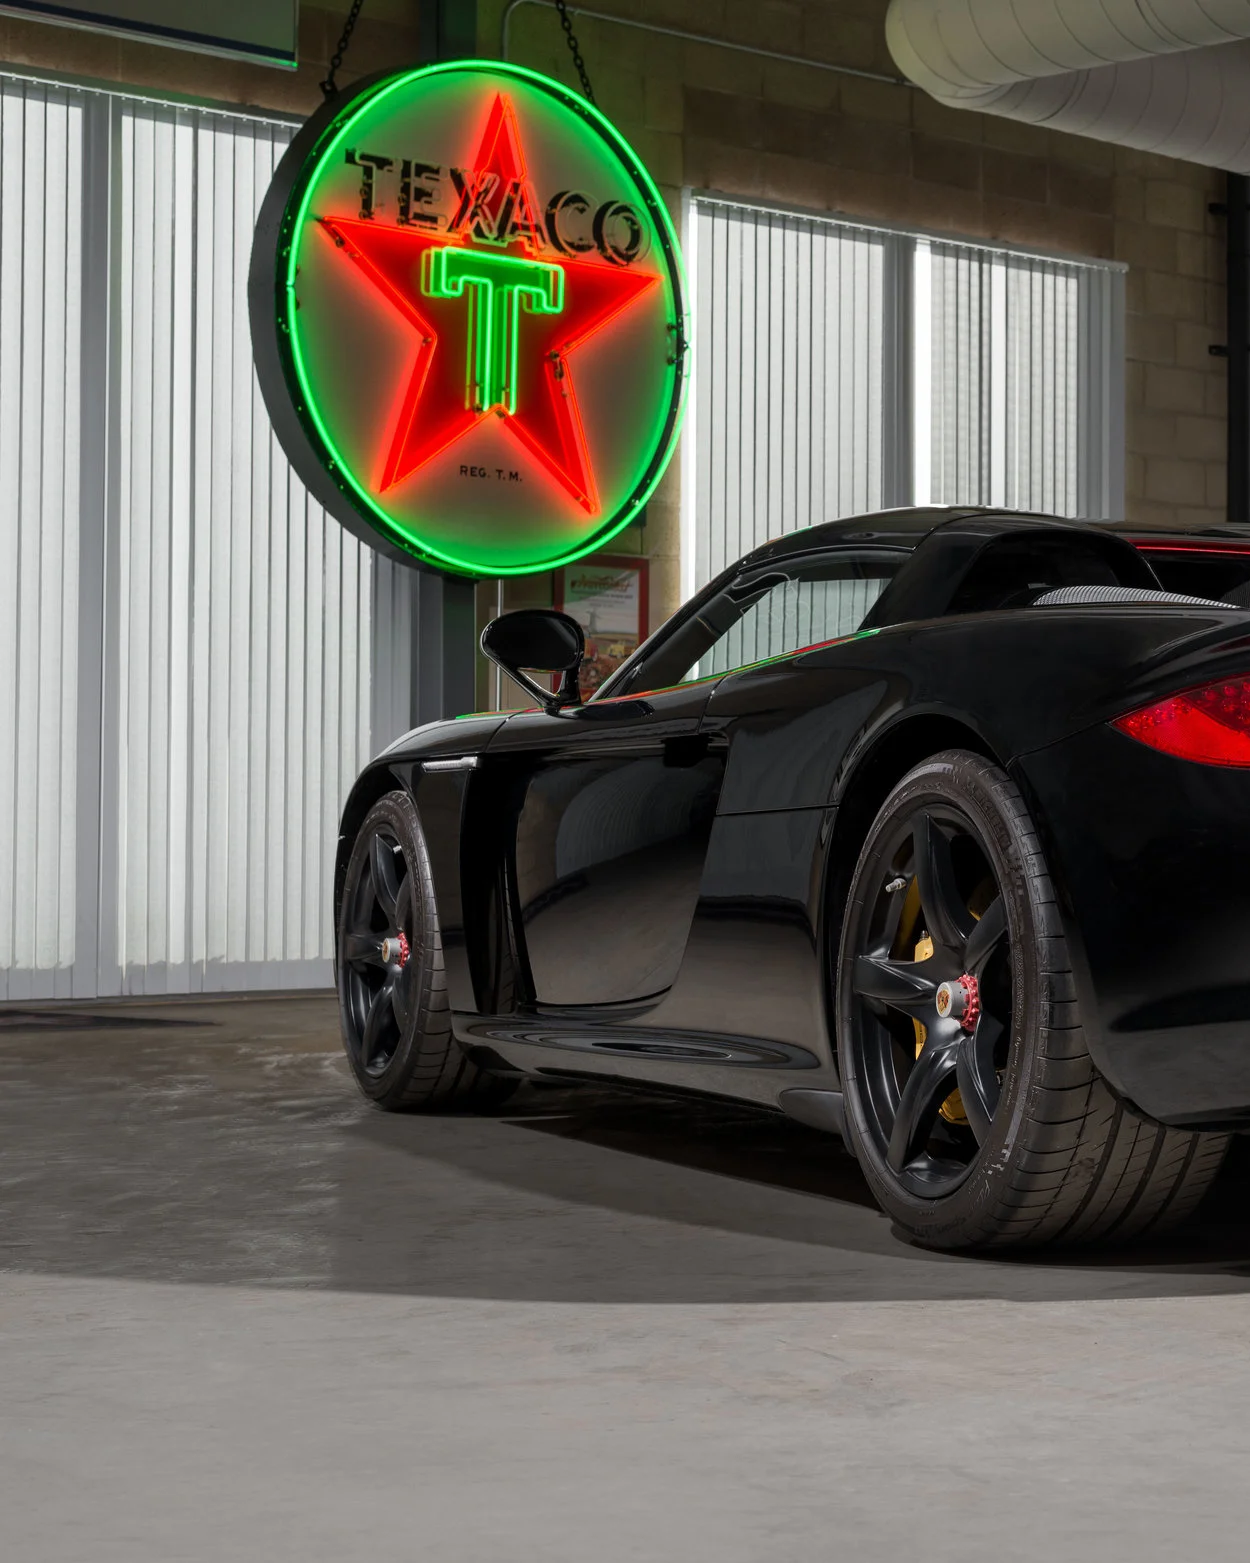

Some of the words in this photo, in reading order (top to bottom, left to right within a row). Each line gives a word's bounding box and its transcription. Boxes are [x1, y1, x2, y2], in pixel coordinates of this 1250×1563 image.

[344, 148, 652, 267] TEXACO
[422, 246, 565, 416] T
[459, 465, 491, 478] REG.
